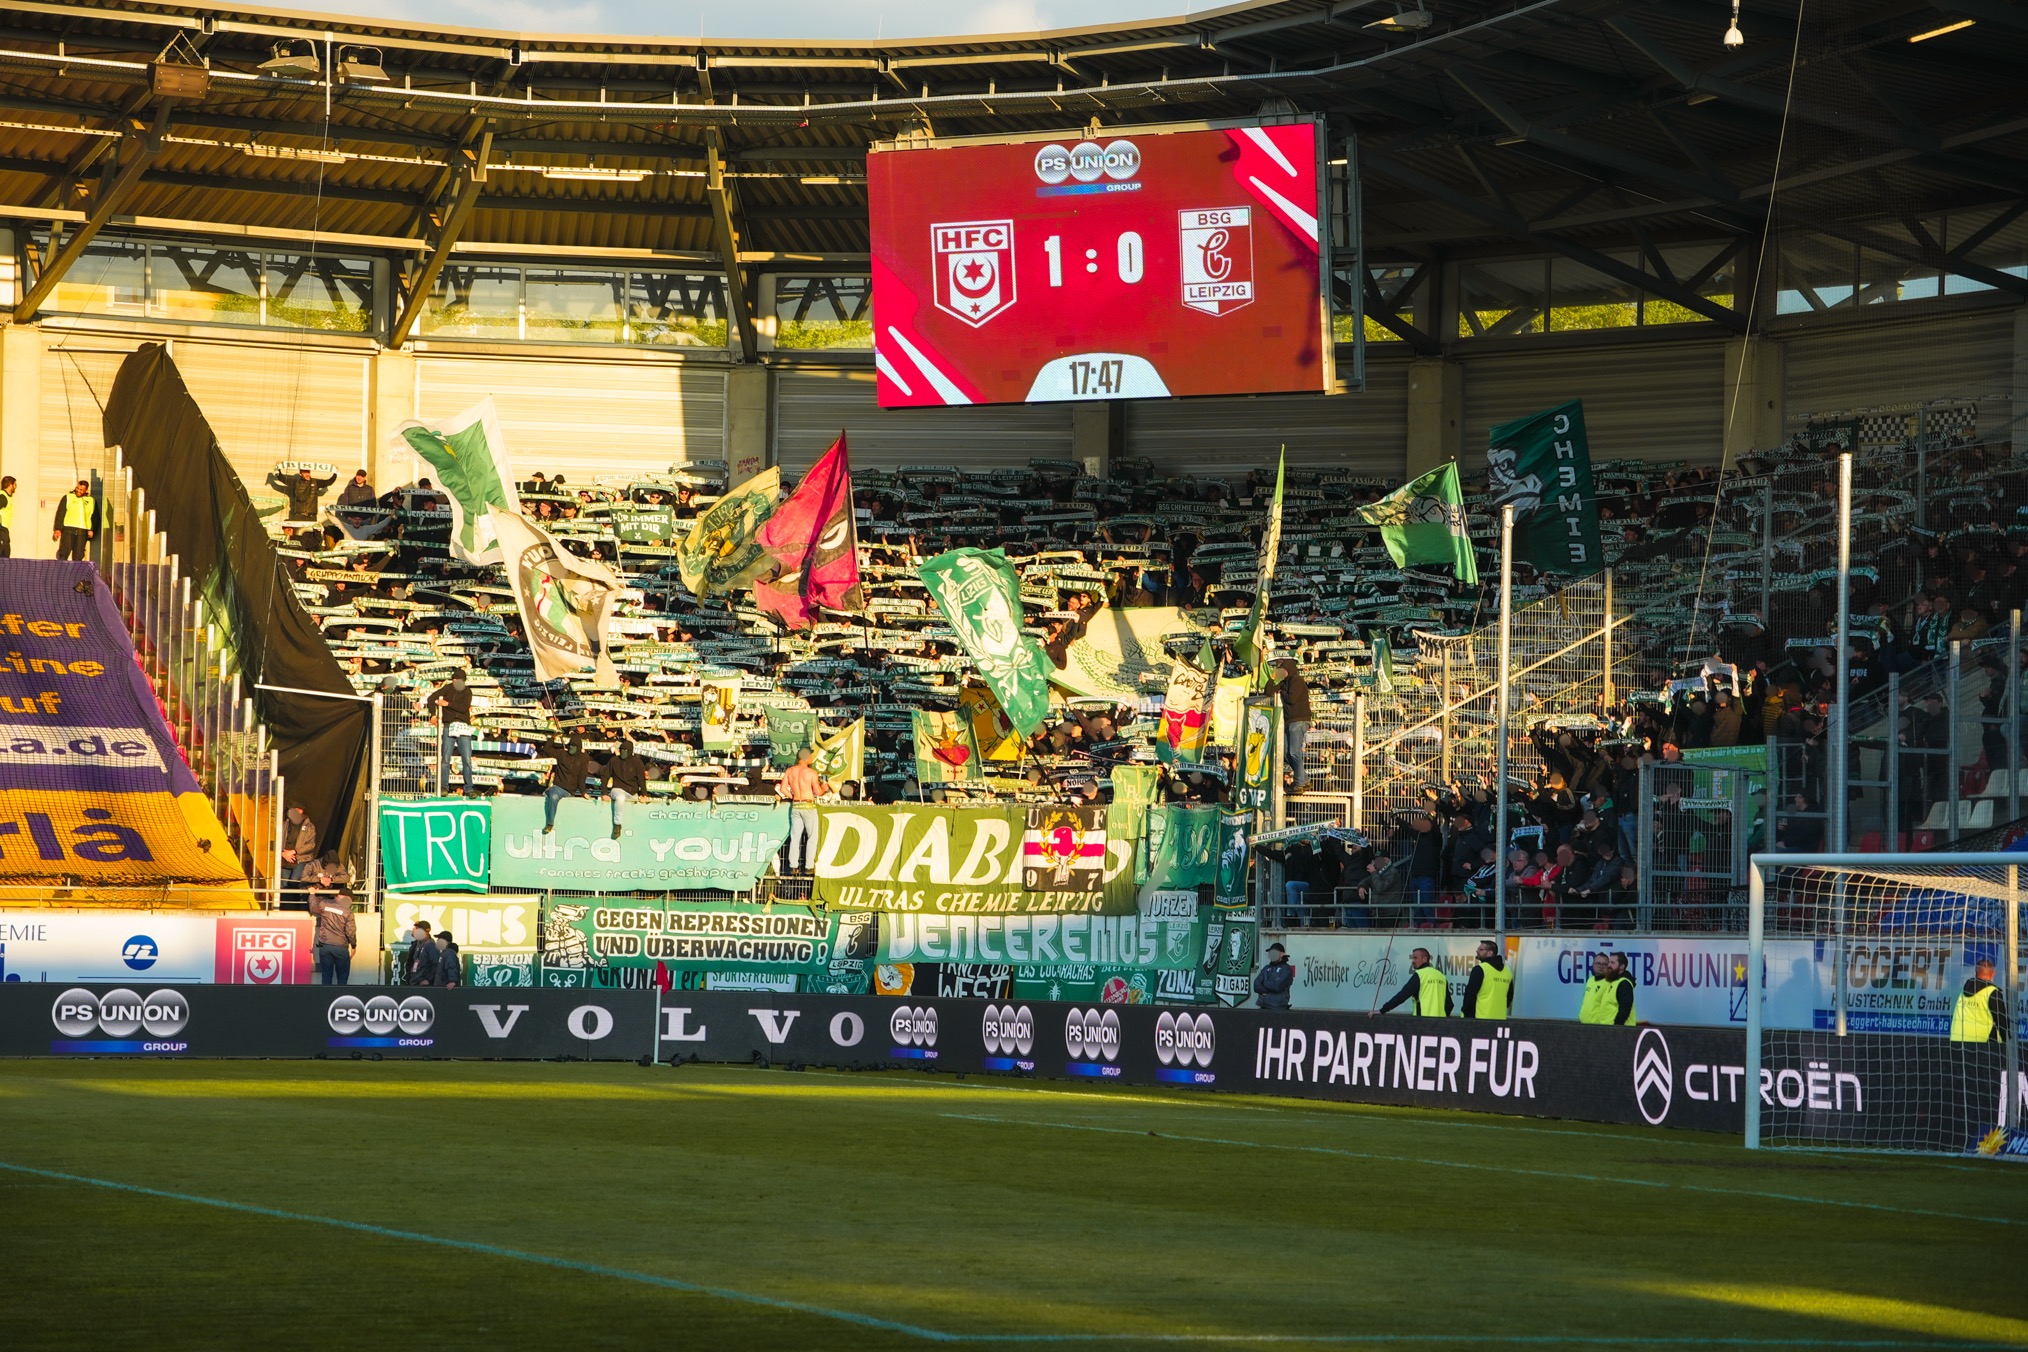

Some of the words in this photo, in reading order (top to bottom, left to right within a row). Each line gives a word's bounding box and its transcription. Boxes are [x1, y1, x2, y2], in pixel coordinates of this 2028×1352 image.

[1041, 157, 1066, 171] PS
[1072, 151, 1134, 169] UNION
[1106, 182, 1142, 193] GROUP
[1197, 212, 1232, 226] BSG
[941, 228, 1004, 249] HFC
[1188, 284, 1246, 299] LEIPZIG
[1069, 361, 1124, 395] 17:47
[1158, 503, 1170, 511] BSG
[1171, 504, 1192, 512] CHEMIE
[1193, 505, 1216, 513] LEIPZIG
[621, 522, 640, 533] MIT
[641, 522, 661, 535] DIR
[630, 514, 669, 525] IMMER
[489, 604, 517, 612] CHEMIE
[1354, 597, 1377, 606] CHEMIE
[1377, 594, 1399, 603] LEIPZIG
[0, 613, 87, 639] fer
[0, 651, 105, 677] ine
[0, 735, 148, 757] a.de
[646, 782, 675, 791] CHEMIE
[1028, 808, 1040, 828] U
[1093, 809, 1106, 829] F
[382, 809, 486, 878] TRC
[1026, 869, 1038, 888] 9
[1087, 873, 1098, 891] 7
[838, 886, 925, 911] ULTRAS
[935, 891, 1018, 913] CHEMIE
[1143, 892, 1198, 917] URZEN
[394, 905, 527, 946] SKINS
[596, 909, 664, 931] GEGEN
[668, 913, 829, 938] REPRESSIONEN
[850, 914, 870, 923] BSG
[239, 934, 289, 949] HFC
[595, 935, 639, 957] UND
[647, 932, 812, 960] ÜBERWACHUNG
[1156, 969, 1196, 994] ZONA
[1353, 961, 1379, 989] Edel
[1917, 994, 1951, 1011] GmbH
[60, 1004, 94, 1022] PS
[101, 1003, 180, 1022] UNION
[334, 1007, 360, 1022] PS
[365, 1007, 428, 1023] UNION
[469, 1004, 865, 1047] VOLVO
[895, 1019, 912, 1032] PS
[912, 1019, 937, 1035] UNION
[985, 1022, 998, 1037] PS
[1000, 1021, 1031, 1039] UNION
[1827, 1014, 1950, 1032] w.eggert-haustechnik.de
[398, 1038, 434, 1047] GROUP
[1068, 1024, 1082, 1041] PS
[1084, 1024, 1119, 1045] UNION
[1158, 1030, 1173, 1047] PS
[1175, 1031, 1212, 1051] UNION
[143, 1041, 188, 1052] GROUP
[925, 1050, 939, 1059] GROUP
[1102, 1066, 1121, 1076] GROUP
[1255, 1027, 1307, 1082] IHR
[1312, 1030, 1461, 1093] PARTNER
[1468, 1027, 1539, 1099] FÜR
[1195, 1073, 1216, 1084] GROUP
